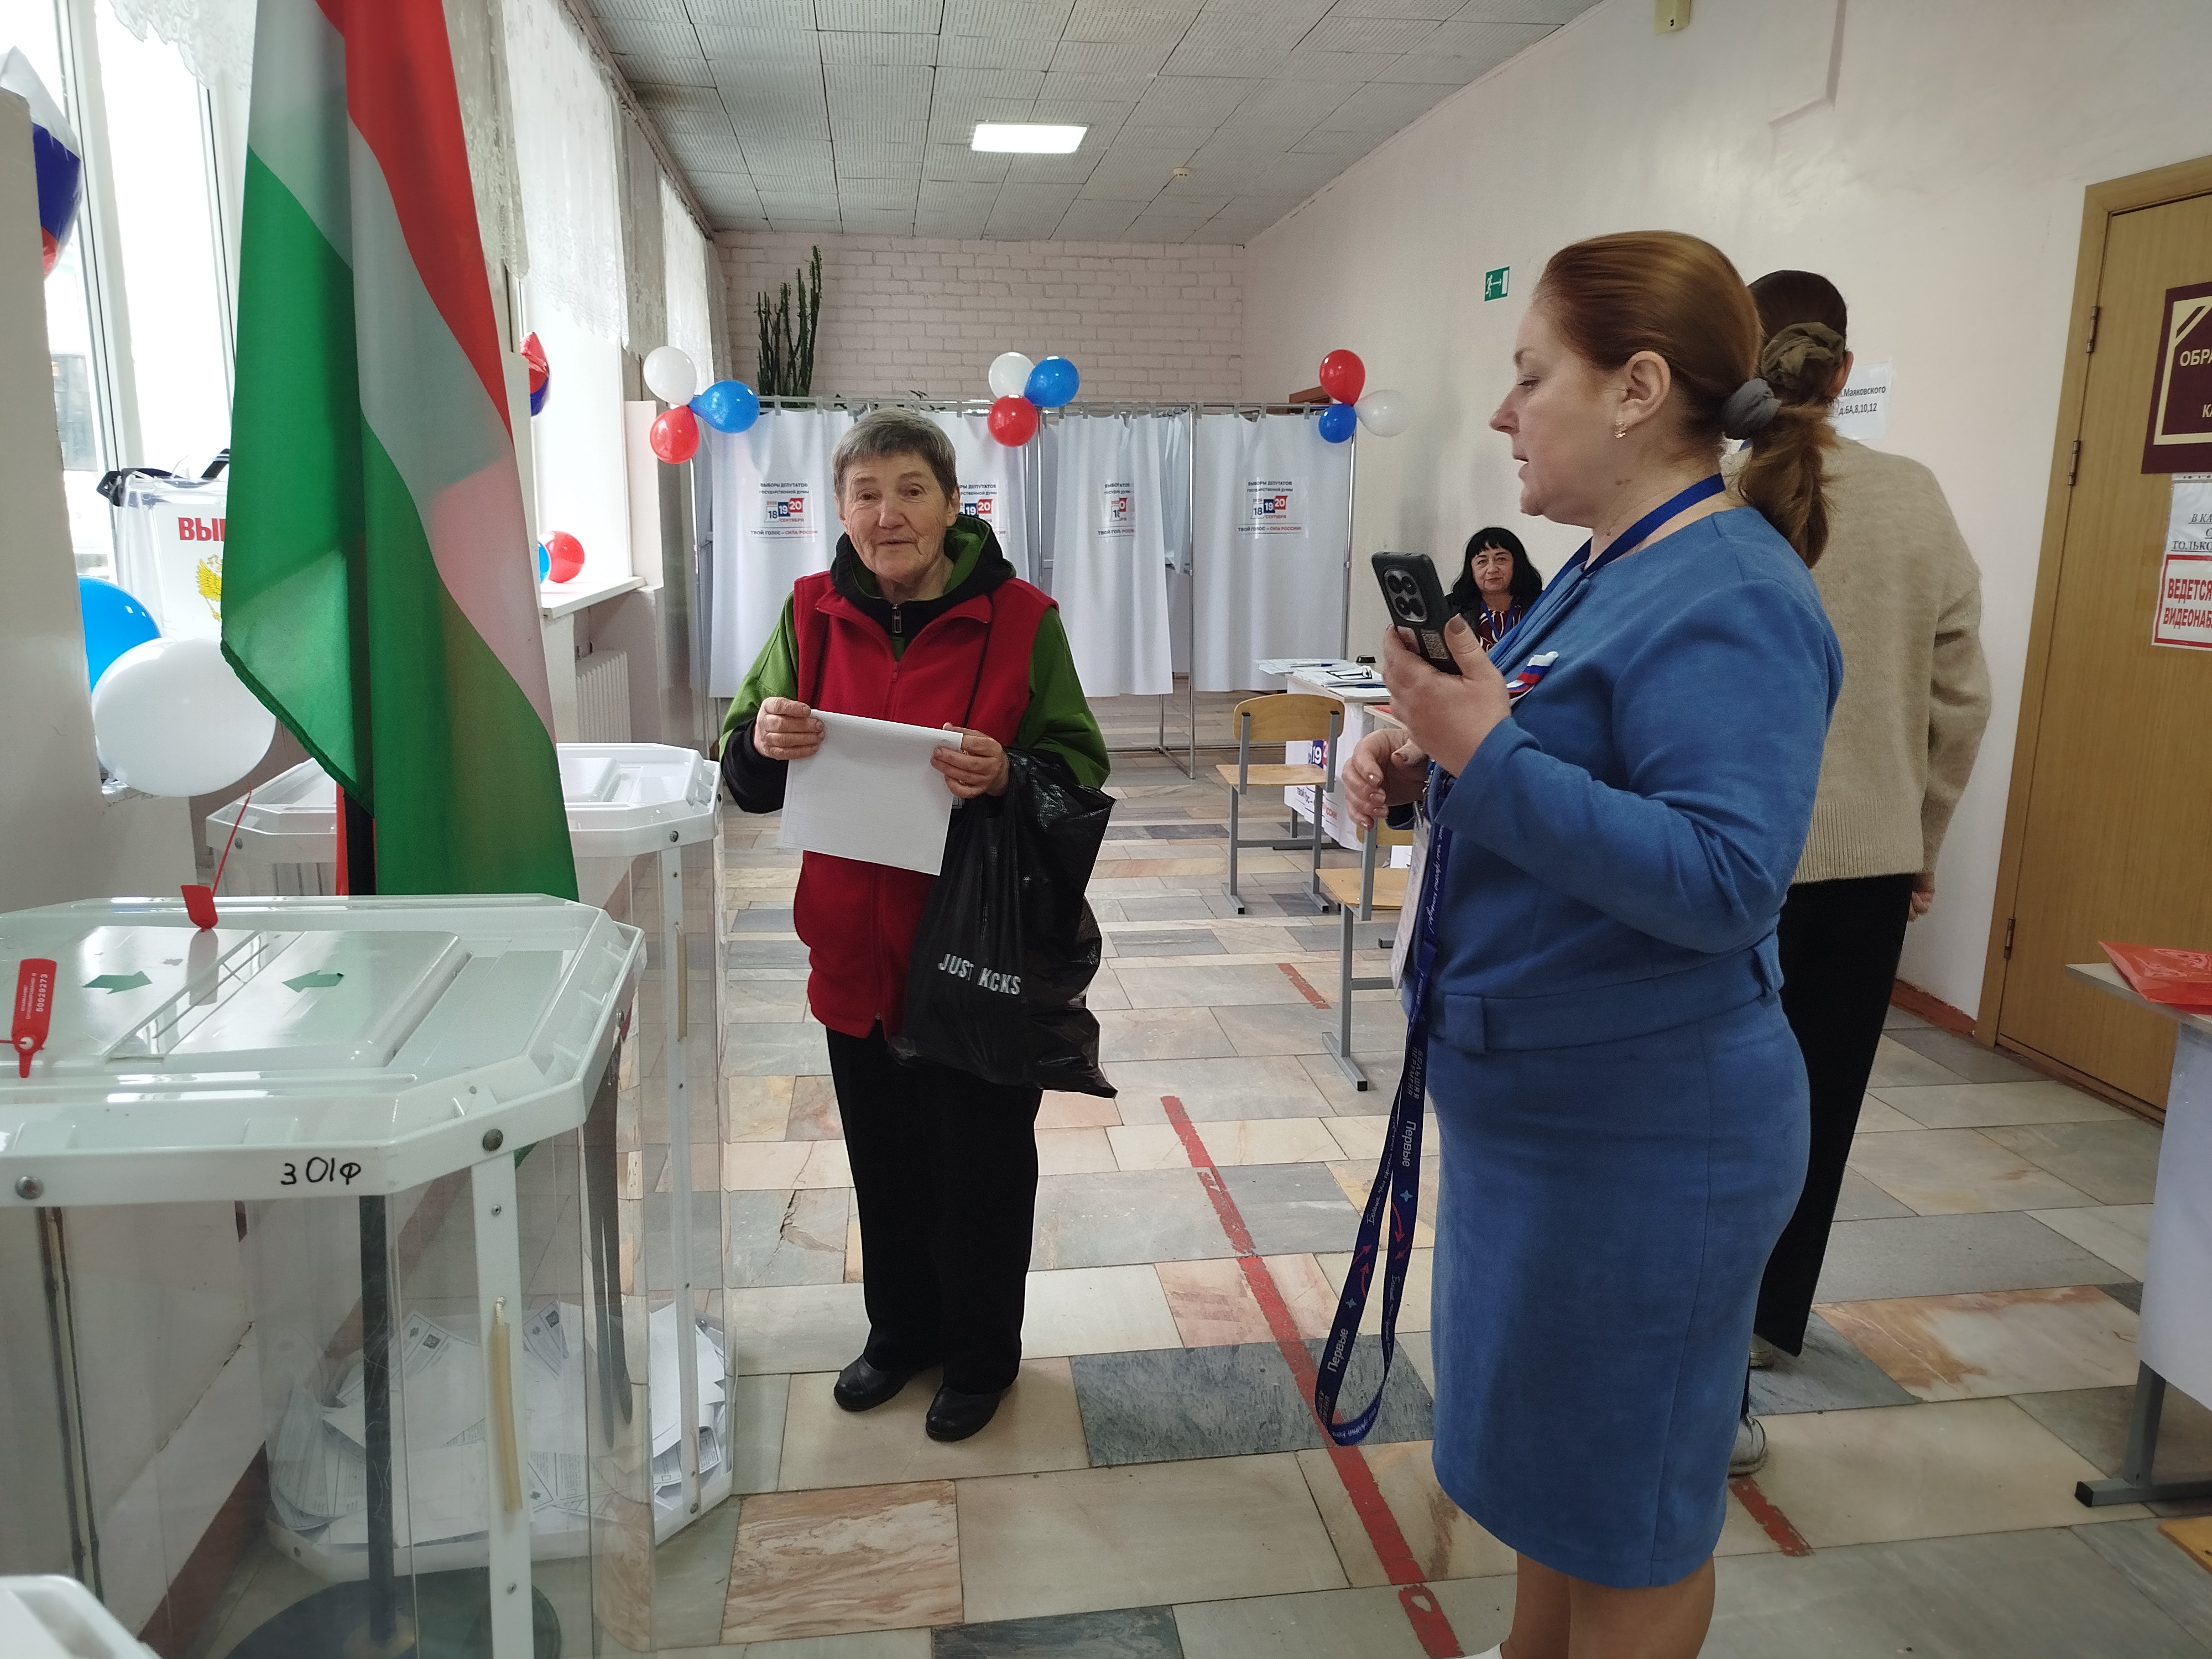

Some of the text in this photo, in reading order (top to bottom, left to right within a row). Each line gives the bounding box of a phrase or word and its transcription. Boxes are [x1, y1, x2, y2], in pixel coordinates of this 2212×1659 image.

[1839, 403, 1877, 416] д.6А,8,10,12
[768, 500, 802, 519] 18 19 20
[966, 502, 990, 515] 19 20
[1254, 498, 1285, 515] 18 19 20
[2191, 513, 2198, 523] В
[2168, 578, 2212, 604] ВЕДЕТСЯ
[2163, 607, 2212, 629] ВИДЕОНАБ
[1312, 745, 1322, 764] 19
[938, 953, 974, 981] JUST
[1413, 1050, 1423, 1099] БОЛЬШАЯ
[1401, 1120, 1417, 1167] Первые
[1327, 1328, 1348, 1373] Первые
